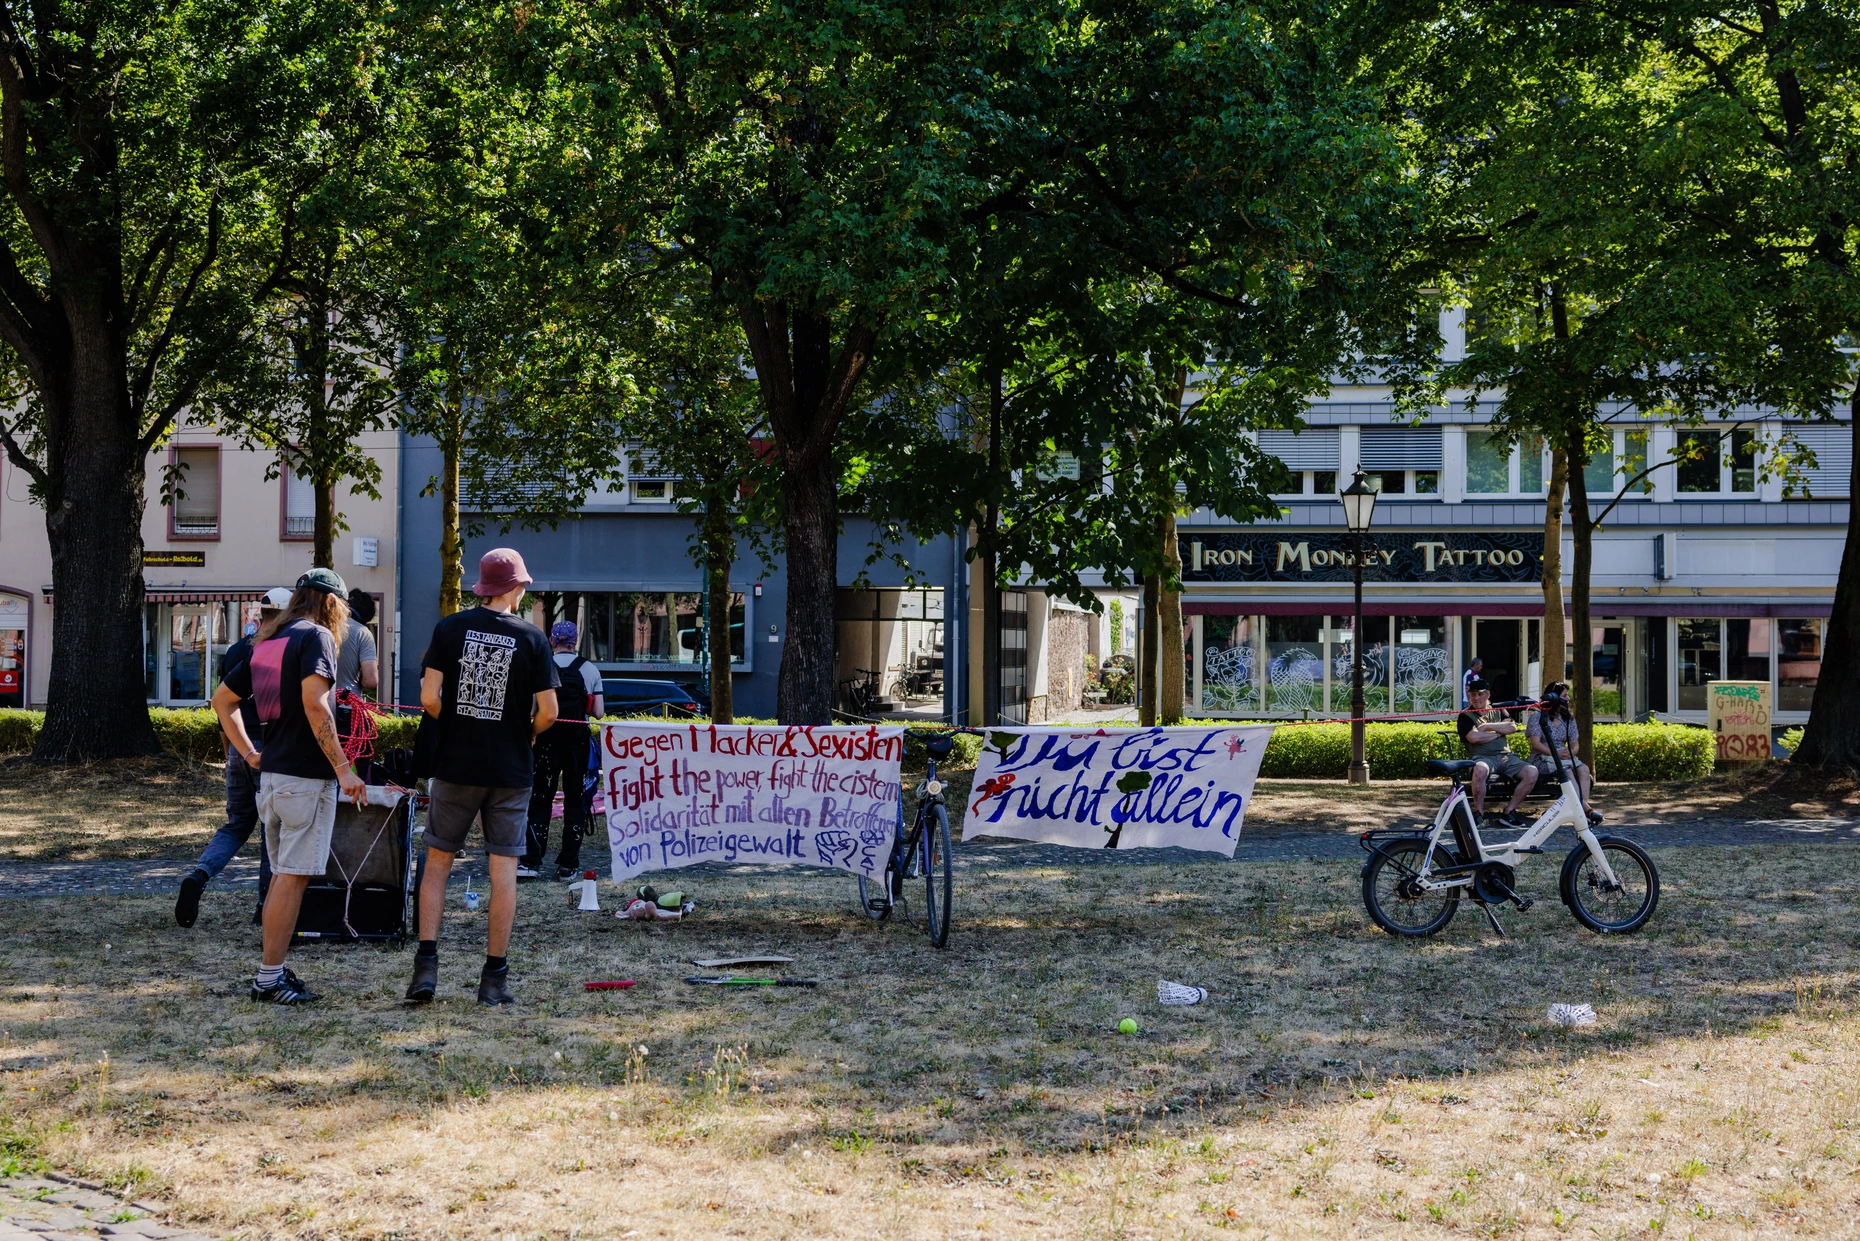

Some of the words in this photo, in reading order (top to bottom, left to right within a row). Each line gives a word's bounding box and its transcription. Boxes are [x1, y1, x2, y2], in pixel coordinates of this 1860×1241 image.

[770, 624, 778, 634] 9
[1208, 648, 1253, 665] TATTOO
[1400, 649, 1445, 667] PIERCING
[605, 725, 683, 766] Gegen
[801, 725, 901, 762] Sexisten
[993, 734, 1100, 773] Du
[1107, 726, 1230, 772] bist
[669, 757, 711, 796] the
[716, 768, 763, 803] power,
[767, 759, 807, 800] fight
[810, 759, 839, 794] the
[985, 770, 1115, 826] nicht
[609, 794, 720, 846] Solidarität
[725, 790, 755, 824] mit
[758, 793, 811, 828] allen
[819, 796, 897, 840] Betroffenen
[1533, 810, 1560, 838] HERCULES
[619, 841, 651, 868] von
[660, 828, 806, 867] Polizeigewalt
